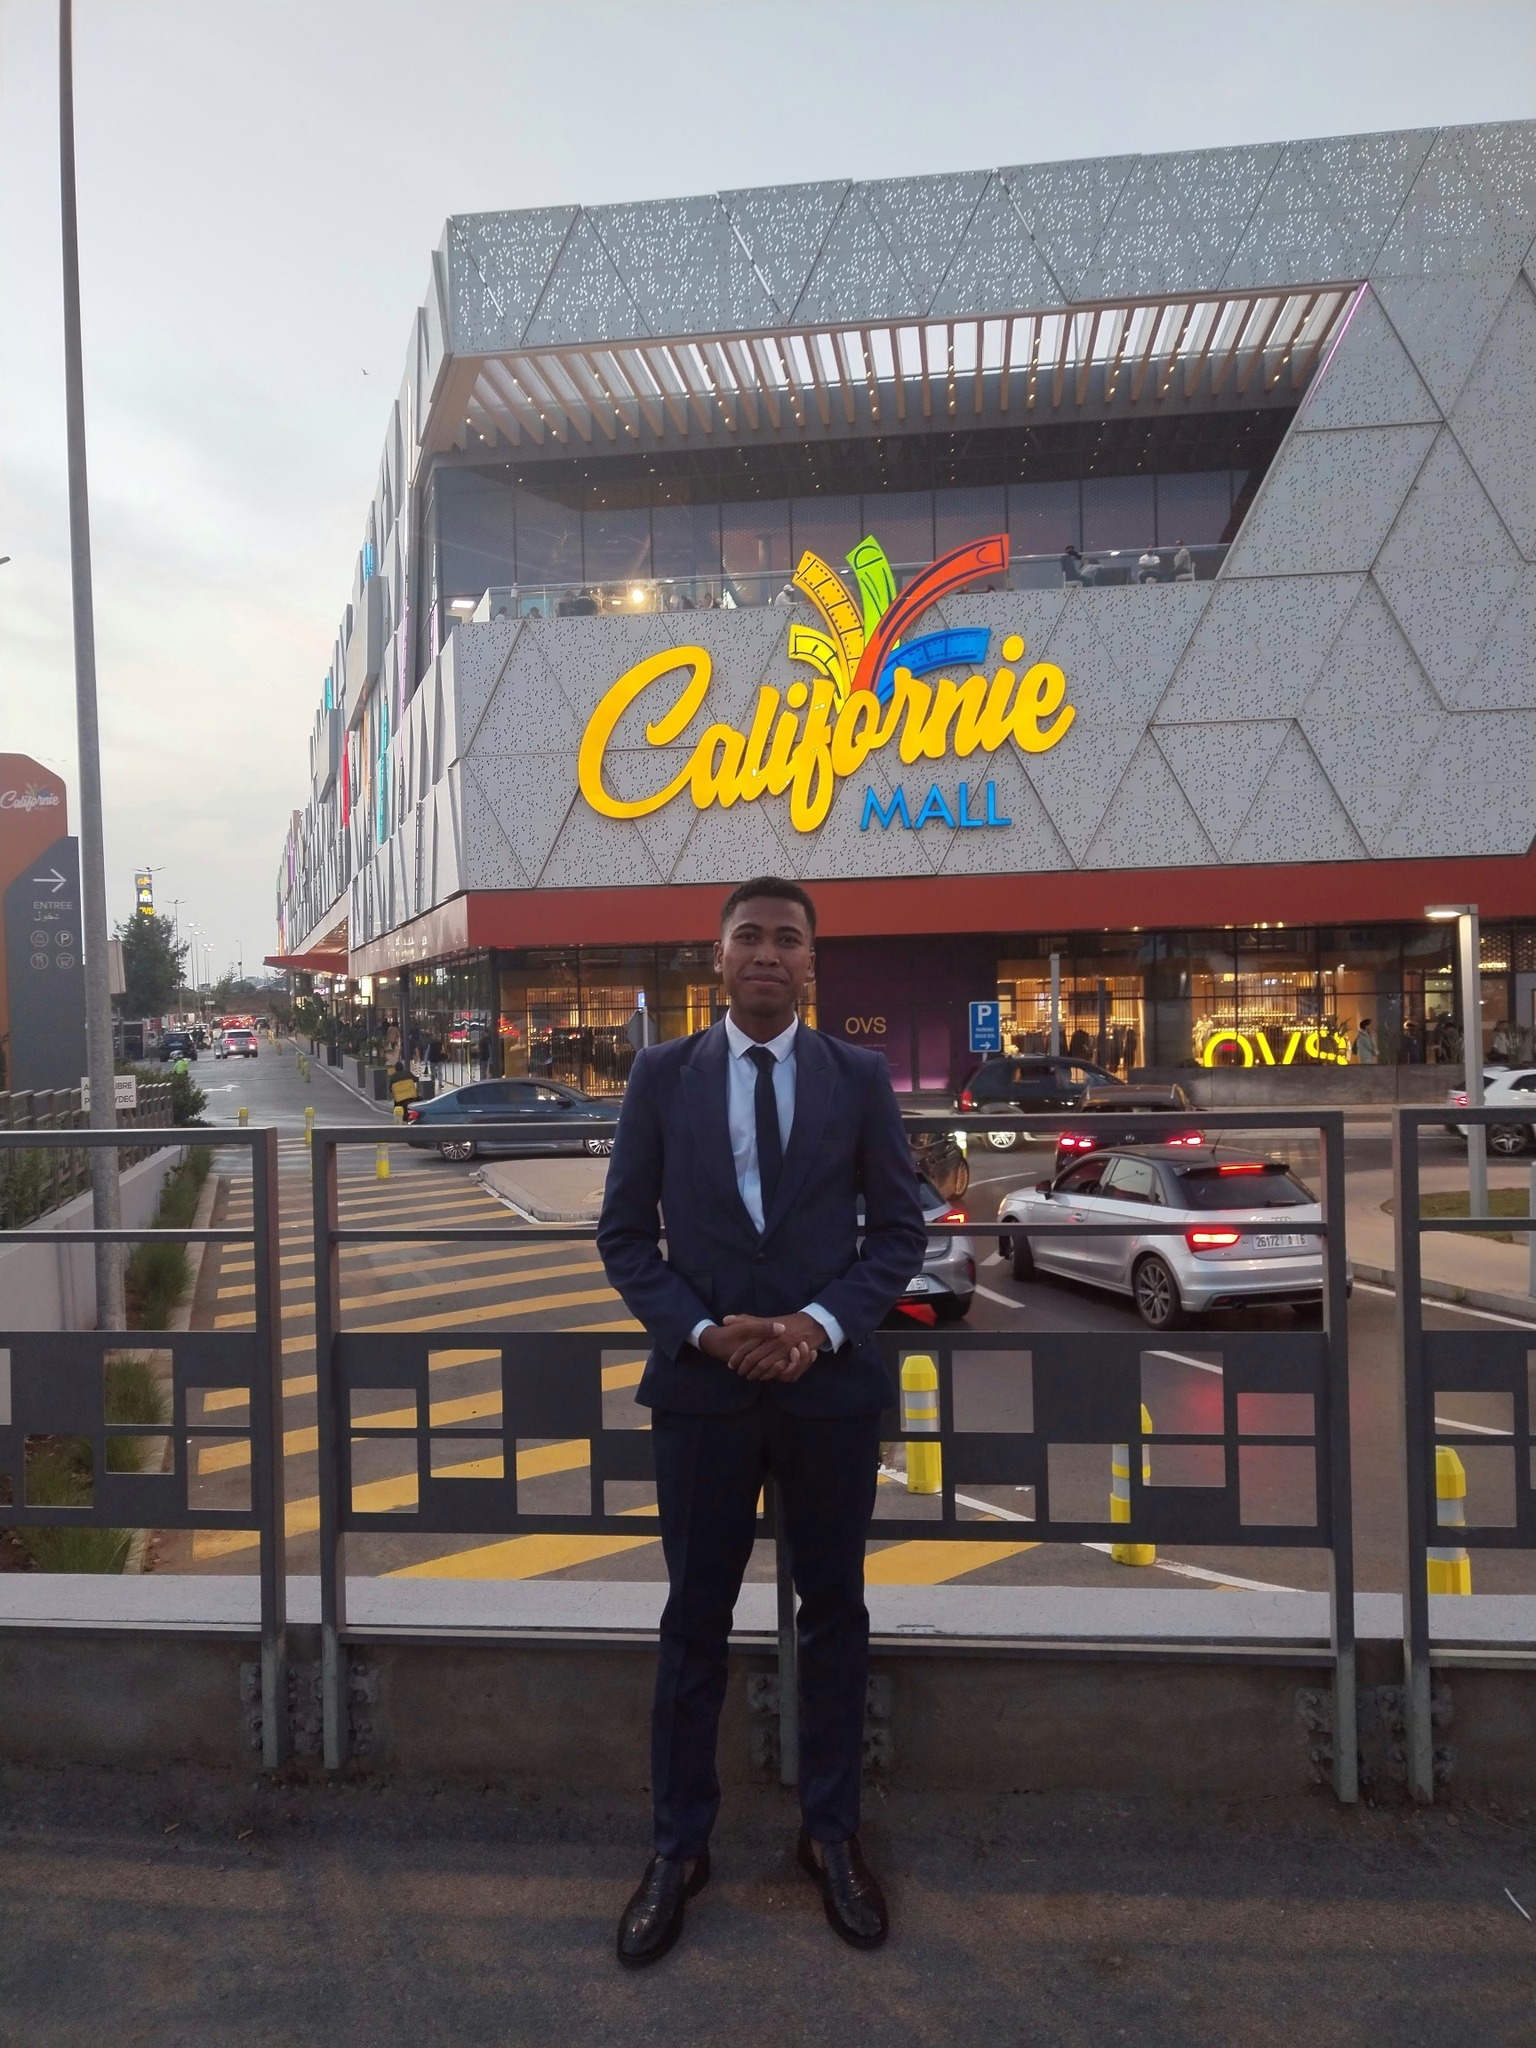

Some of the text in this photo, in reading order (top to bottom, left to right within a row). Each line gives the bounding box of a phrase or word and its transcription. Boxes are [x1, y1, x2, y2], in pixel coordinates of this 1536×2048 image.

[577, 635, 1076, 832] Californie
[0, 789, 60, 812] Californie
[859, 780, 1012, 832] MALL
[845, 1016, 887, 1035] OVS
[977, 1004, 992, 1026] P
[1203, 1028, 1349, 1068] OVS
[114, 1082, 133, 1090] IBRE
